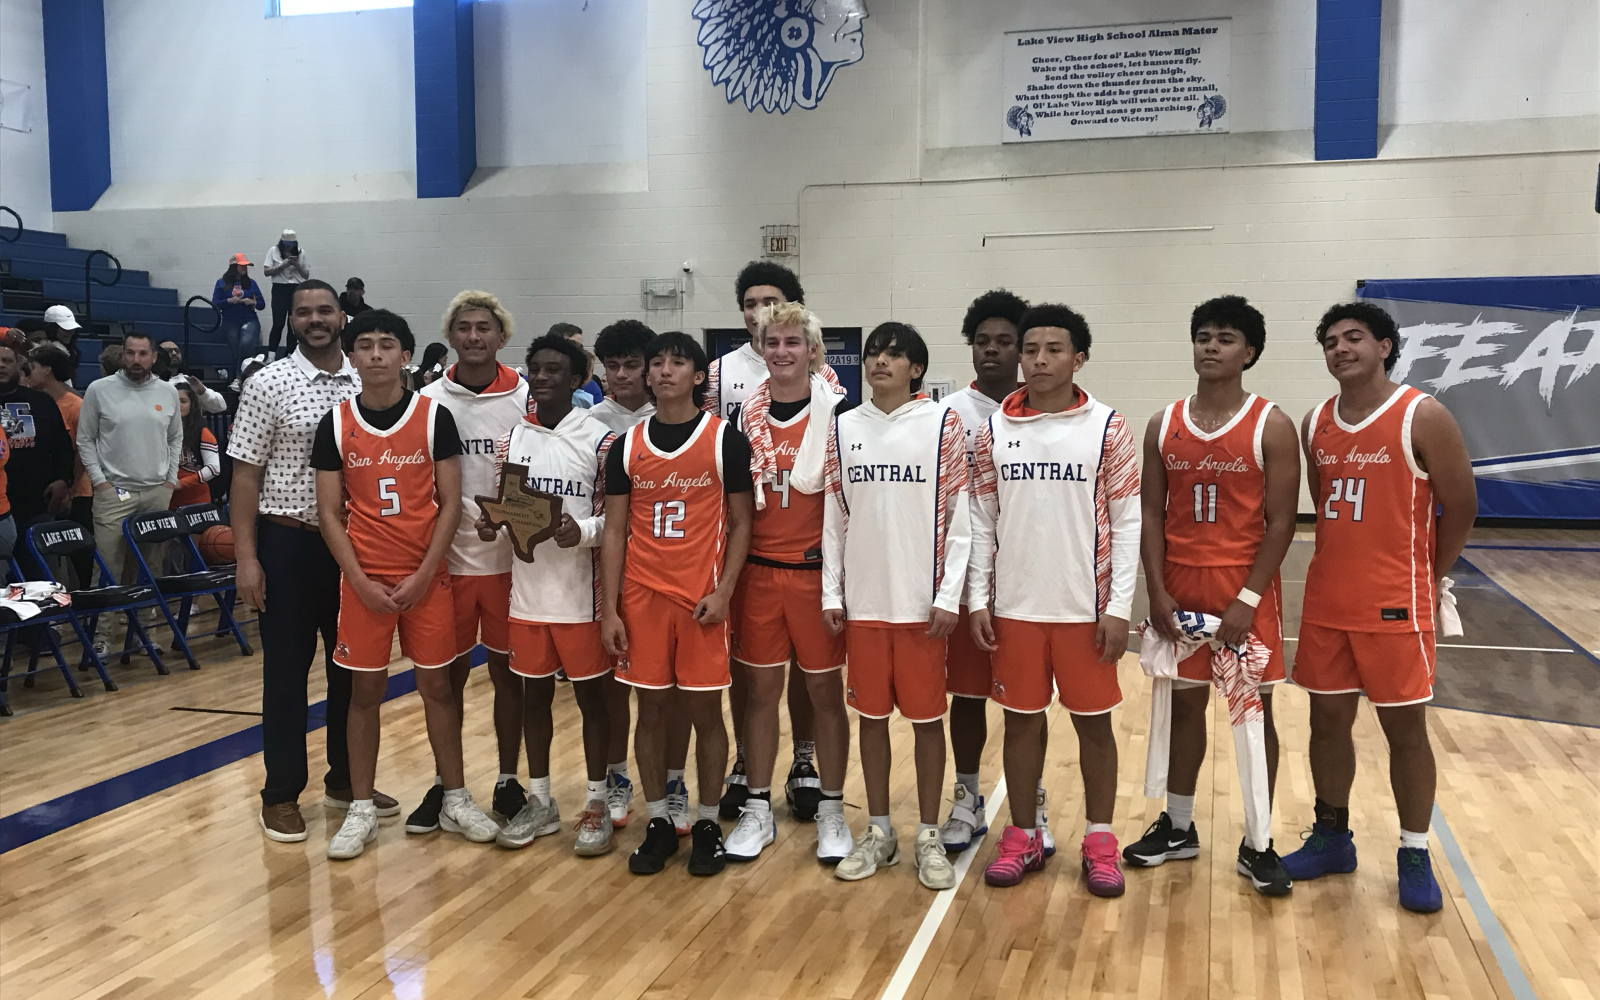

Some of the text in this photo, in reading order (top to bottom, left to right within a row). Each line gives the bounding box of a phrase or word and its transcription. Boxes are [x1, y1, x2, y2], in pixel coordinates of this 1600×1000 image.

[1017, 26, 1218, 46] Lake View High School Alma Mater
[1032, 56, 1062, 64] Cheer,
[1064, 54, 1092, 62] Cheer
[1124, 50, 1146, 58] Lake
[1148, 49, 1172, 57] View
[1174, 47, 1200, 56] High!
[1032, 65, 1056, 73] Wake
[1128, 60, 1142, 68] let
[1143, 58, 1184, 67] banners
[1186, 57, 1202, 66] fly.
[1045, 73, 1068, 81] Send
[1070, 72, 1084, 80] the
[1086, 71, 1116, 80] volley
[1160, 66, 1186, 76] high,
[1015, 94, 1040, 102] What
[1041, 92, 1075, 101] though
[1076, 90, 1092, 98] the
[1118, 88, 1130, 96] be
[1132, 87, 1159, 96] great
[1187, 84, 1218, 92] small,
[1026, 84, 1055, 92] Shake
[1056, 82, 1083, 90] down
[1102, 78, 1140, 88] thunder
[1142, 78, 1166, 86] from
[1168, 76, 1184, 84] the
[1047, 101, 1070, 109] Lake
[1071, 100, 1094, 108] View
[1095, 98, 1118, 107] High
[1120, 97, 1138, 105] will
[1140, 96, 1158, 104] win
[1184, 94, 1200, 102] all.
[1035, 110, 1062, 119] While
[1081, 108, 1104, 117] loyal
[1144, 104, 1196, 113] marching,
[1070, 114, 1158, 126] Onward to Victory!
[770, 237, 788, 252] EXIT
[348, 448, 426, 470] San Angelo
[774, 440, 800, 462] Ang
[1316, 446, 1392, 470] San Angelo
[848, 464, 926, 484] CENTRAL
[1000, 462, 1088, 482] CENTRAL
[1166, 454, 1249, 477] San Angelo
[526, 476, 586, 498] NTRAL
[632, 471, 713, 494] San Angelo
[770, 469, 791, 509] 4
[378, 476, 401, 517] 5
[1192, 482, 1218, 524] 11
[1324, 477, 1366, 522] 24
[186, 510, 220, 526] LAKE VIEW
[490, 506, 530, 519] TOURNAMENT
[653, 500, 686, 538] 12
[136, 516, 178, 534] LAKE VIEW
[511, 518, 542, 528] CHAMPION
[41, 528, 84, 547] LAKE VIEW
